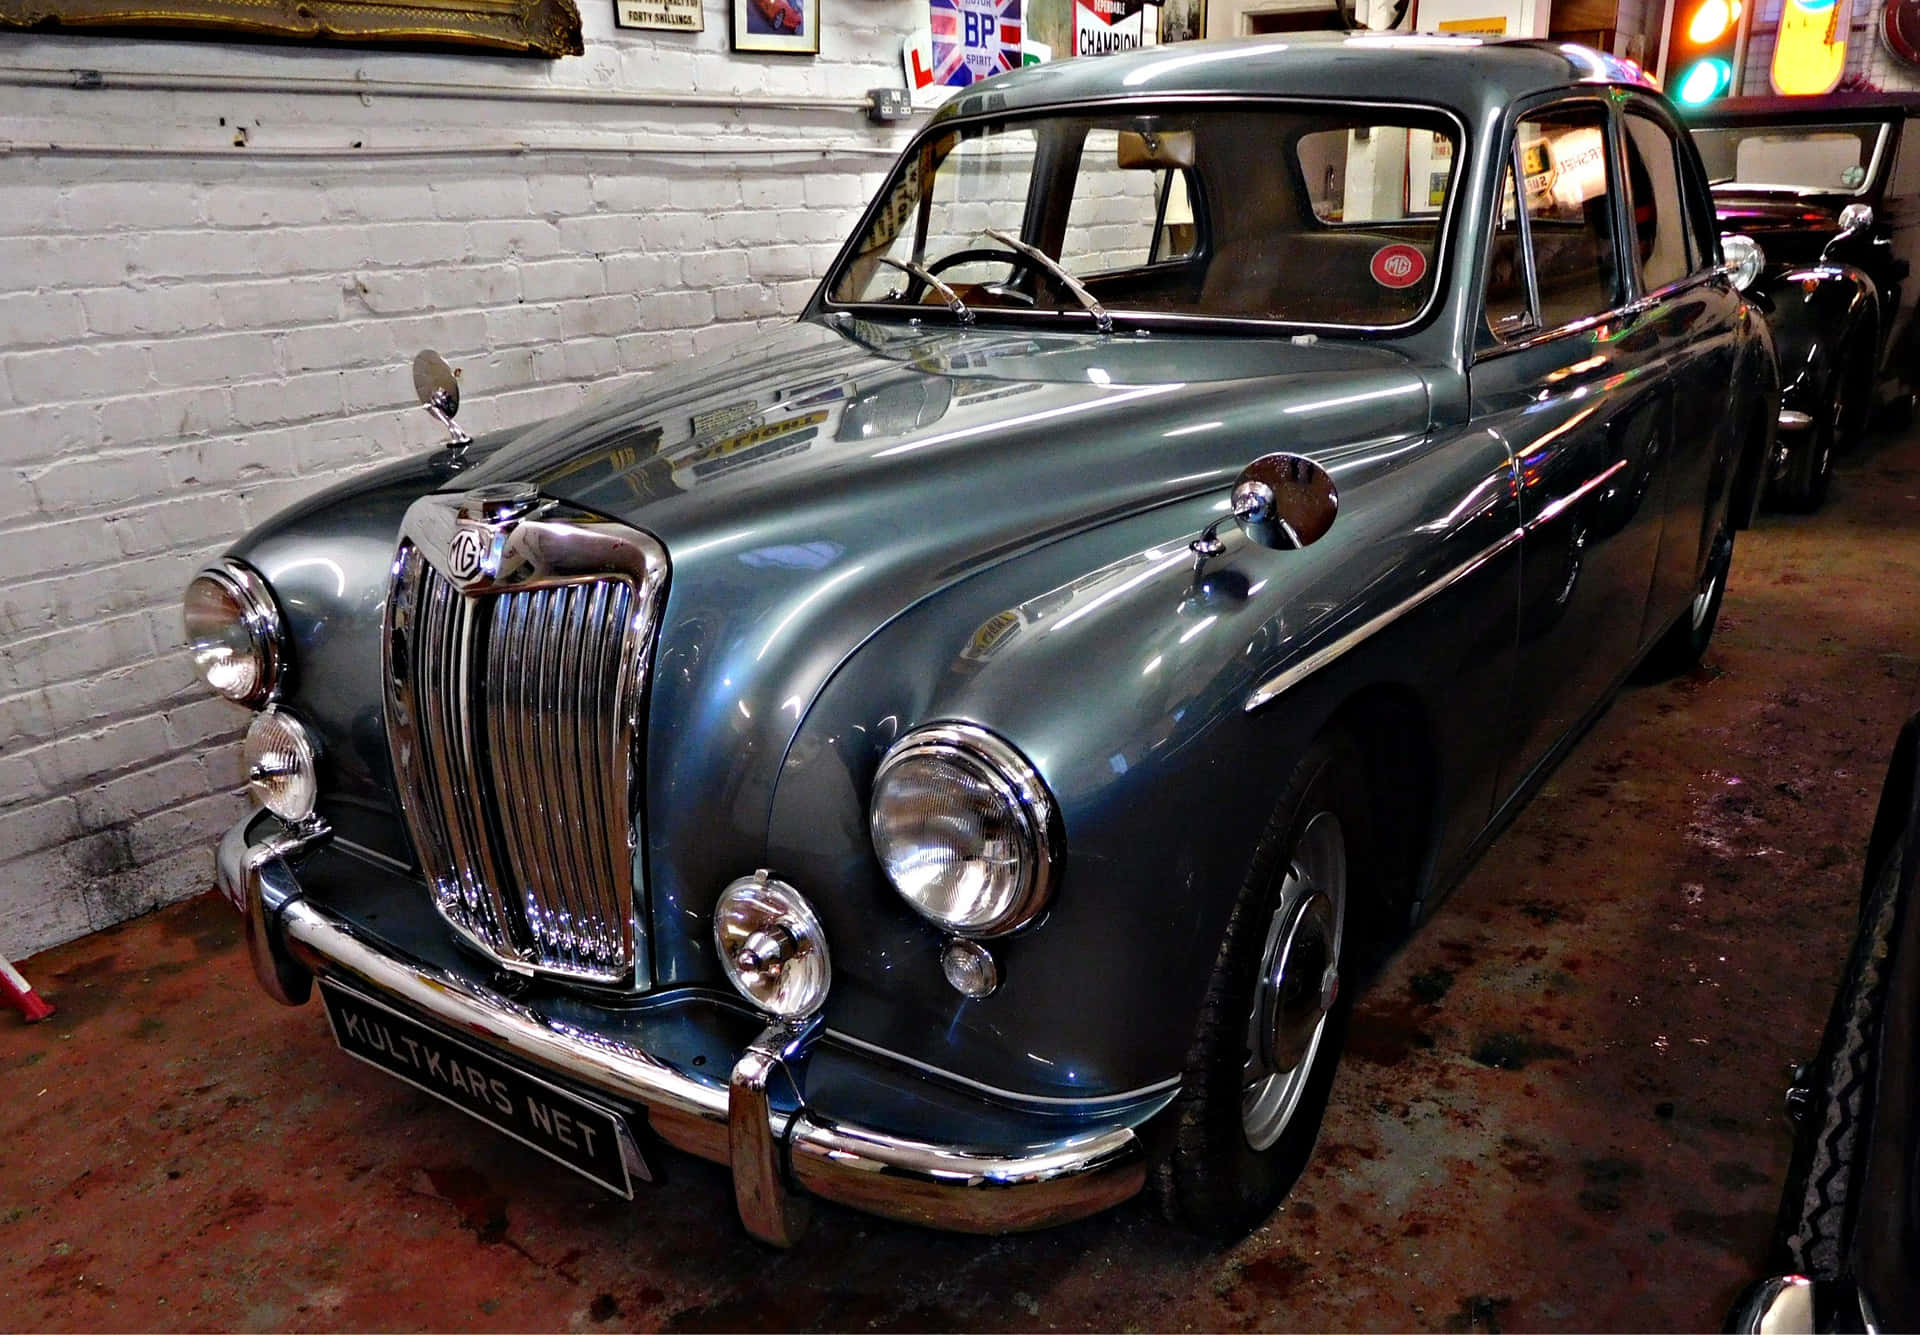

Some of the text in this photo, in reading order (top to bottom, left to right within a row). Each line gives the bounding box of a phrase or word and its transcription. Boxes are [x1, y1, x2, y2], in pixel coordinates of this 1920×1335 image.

[628, 11, 653, 23] FORTY
[1094, 0, 1126, 15] DEPENDABLE
[964, 11, 996, 48] BP
[1080, 28, 1138, 56] CHAMPION
[911, 48, 934, 89] L
[966, 54, 992, 67] SPIRIT
[1386, 257, 1410, 275] MG
[450, 533, 478, 573] MG
[342, 1008, 597, 1158] KULTKARS NET
